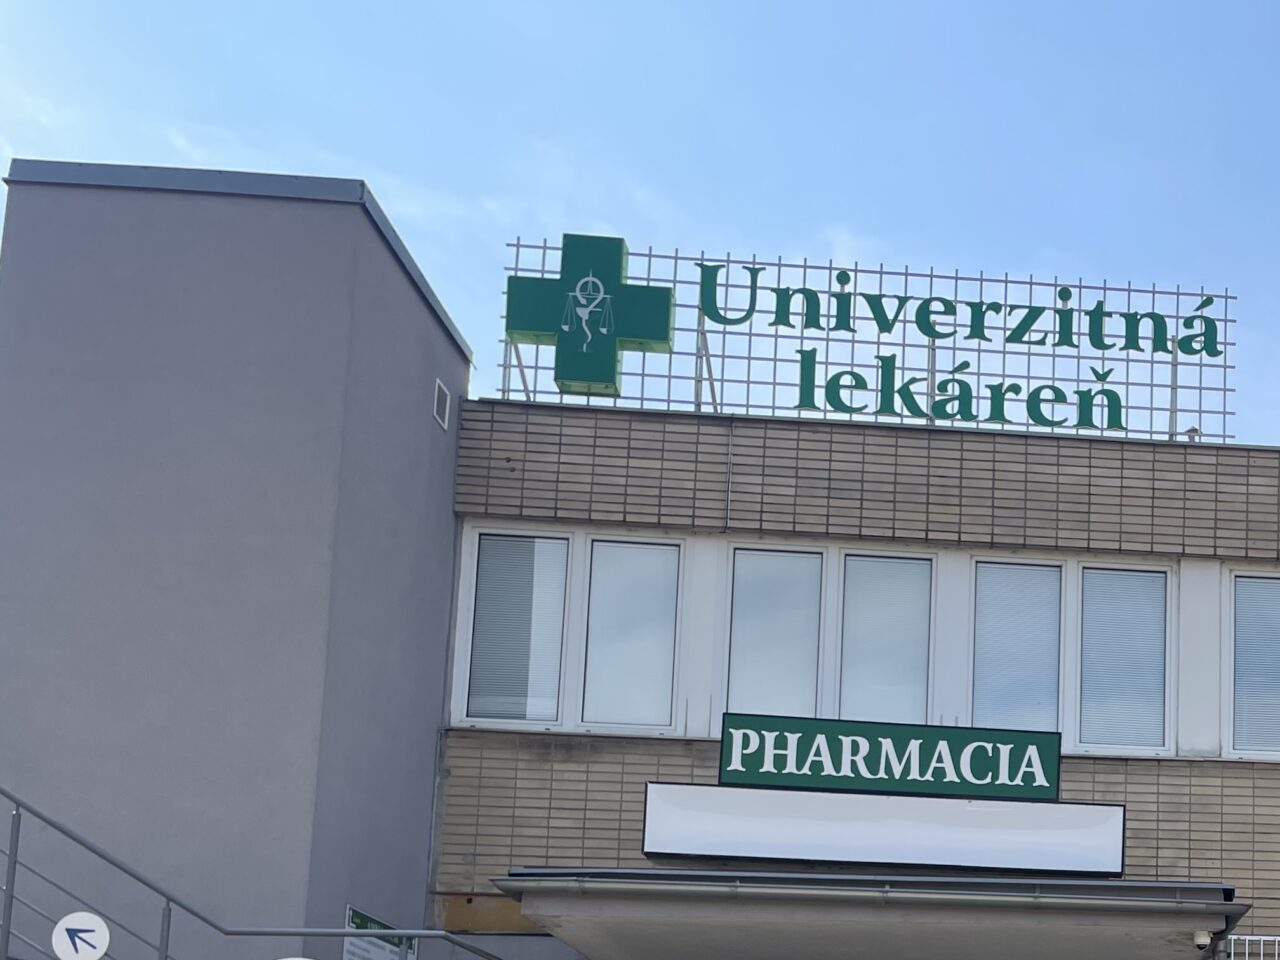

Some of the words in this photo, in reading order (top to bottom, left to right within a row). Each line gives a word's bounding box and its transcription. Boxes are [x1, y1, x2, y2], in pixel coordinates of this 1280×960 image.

[696, 261, 1223, 358] Univerzitná
[794, 346, 1128, 432] lekáreň
[726, 727, 1051, 789] PHARMACIA
